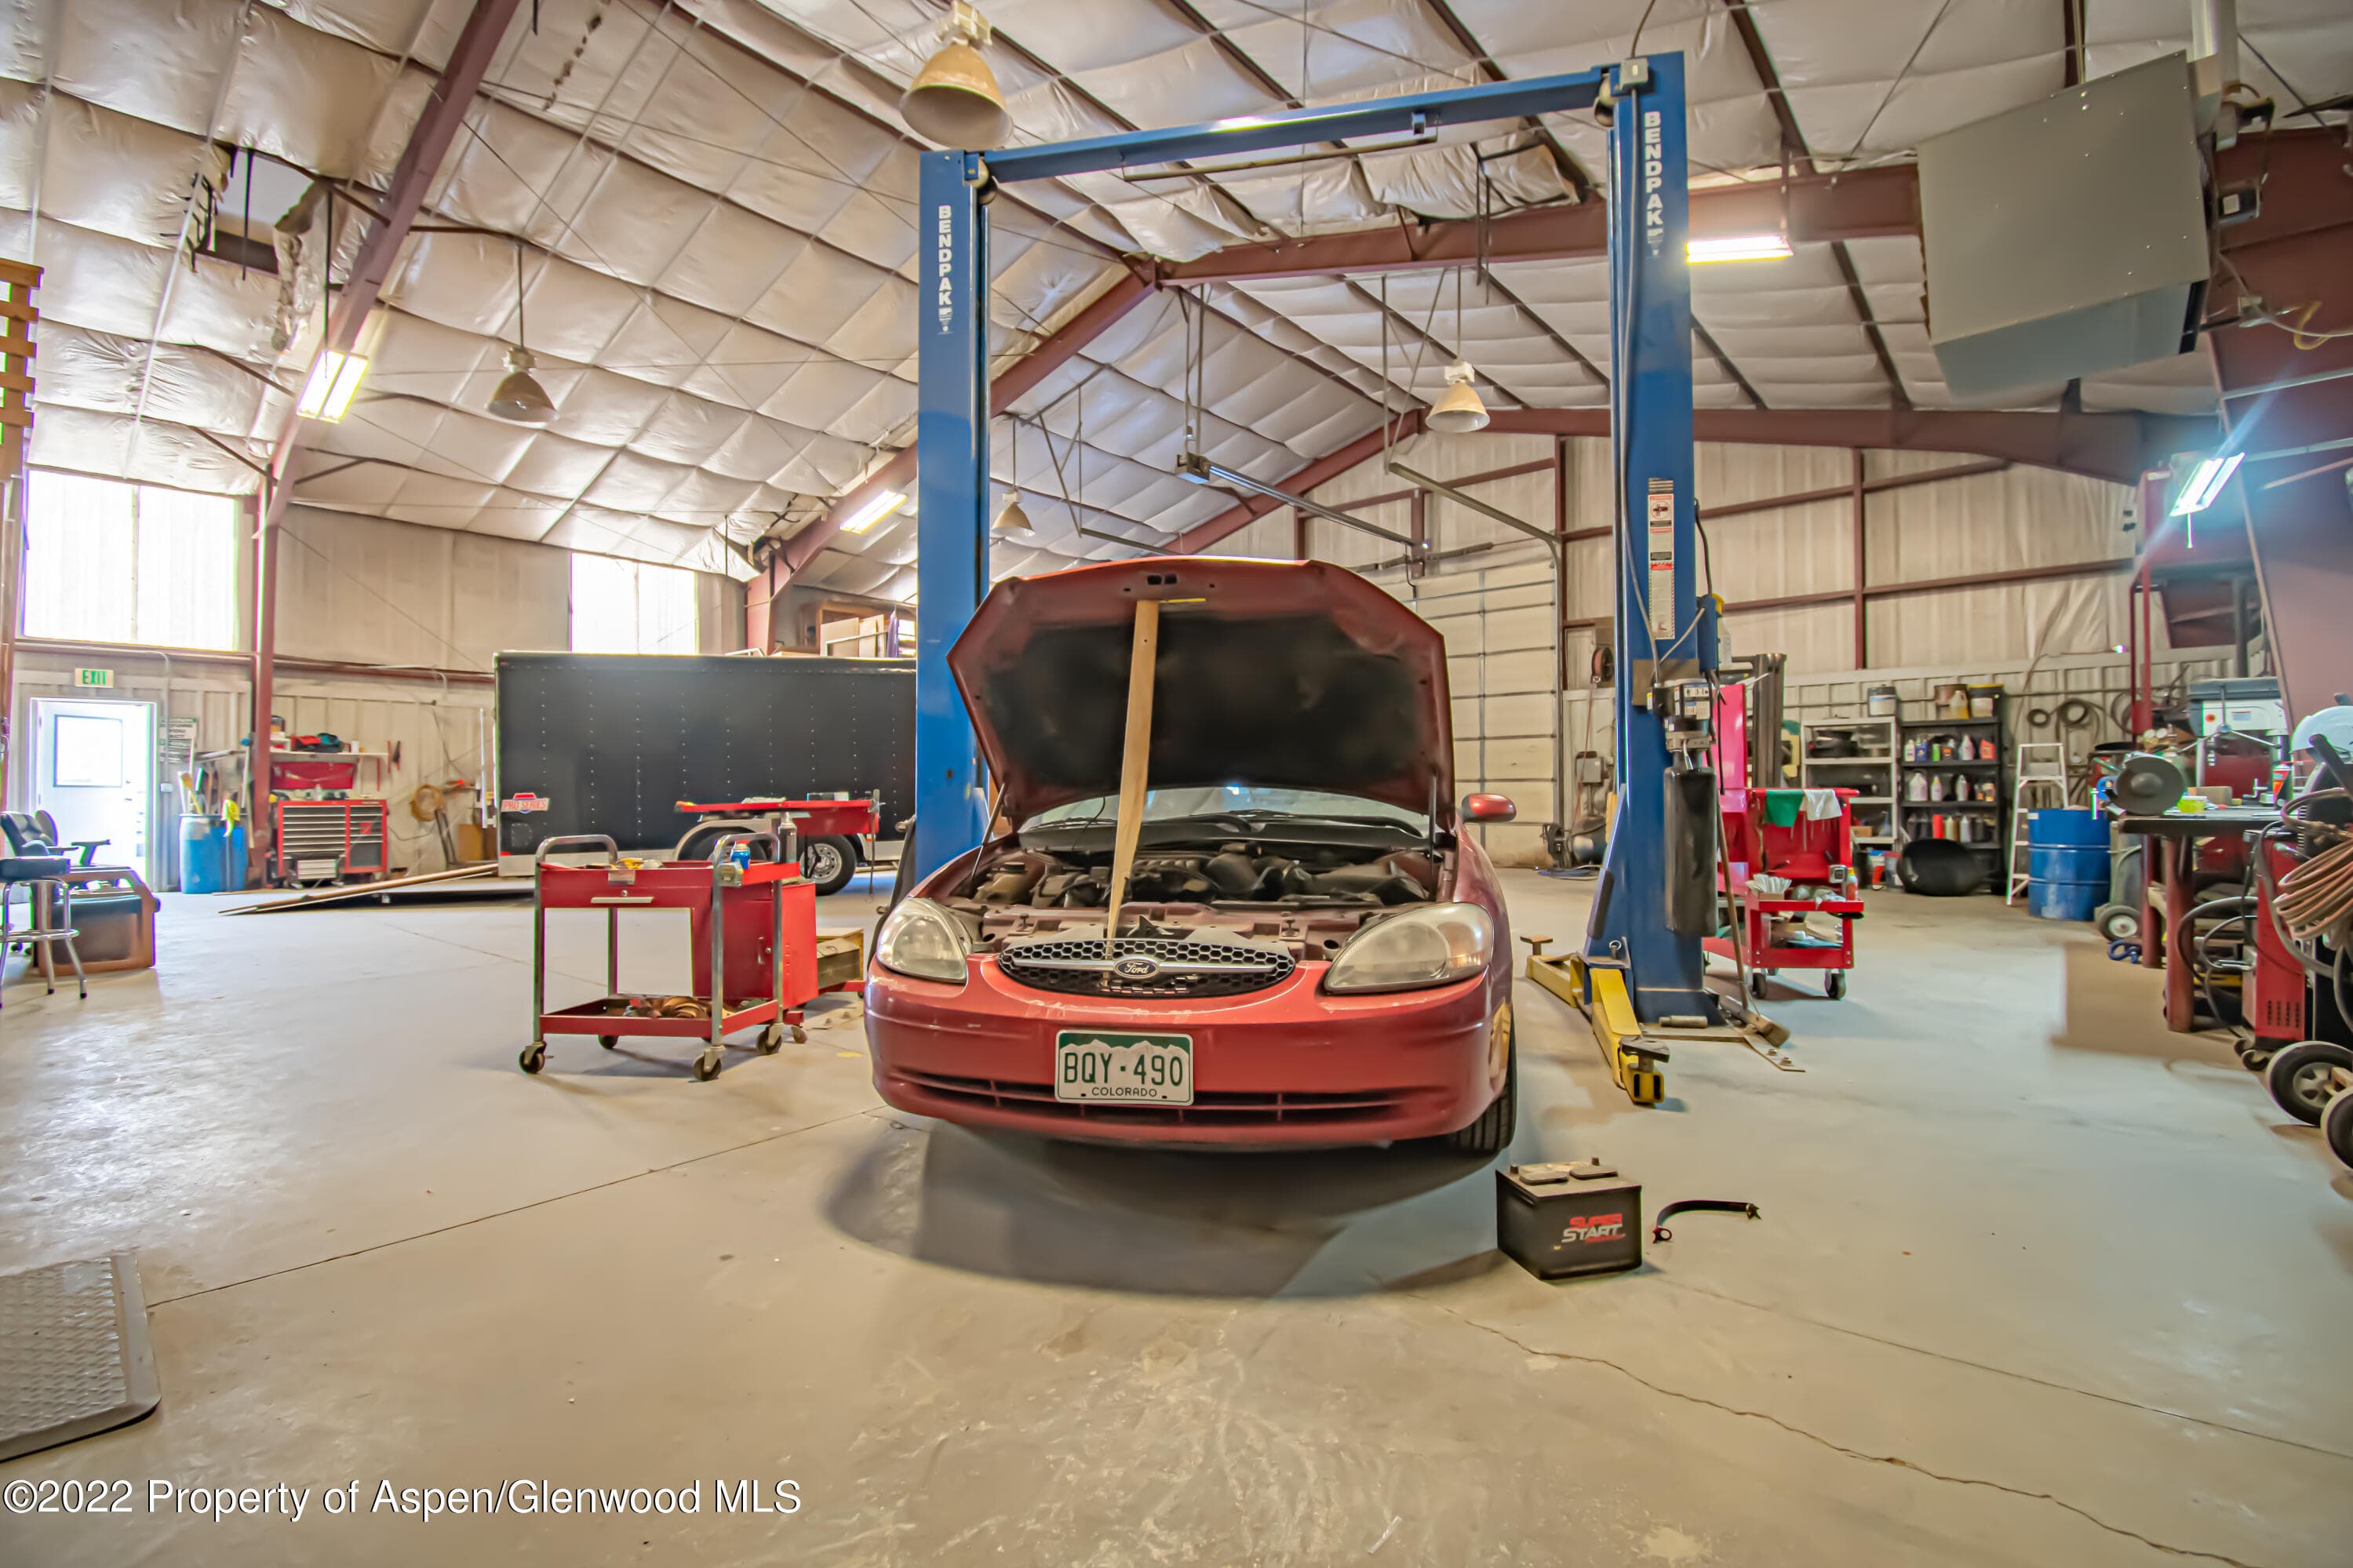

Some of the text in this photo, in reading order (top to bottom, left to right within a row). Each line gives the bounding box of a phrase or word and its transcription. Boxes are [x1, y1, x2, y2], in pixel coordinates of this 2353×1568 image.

[1645, 111, 1663, 226] BENDPAK
[938, 205, 952, 306] BENDPAK
[82, 669, 107, 686] EXIT
[503, 799, 547, 810] PRO SERIES
[1124, 962, 1149, 974] Ford
[1091, 1086, 1157, 1097] COLORADO
[1561, 1223, 1623, 1243] START
